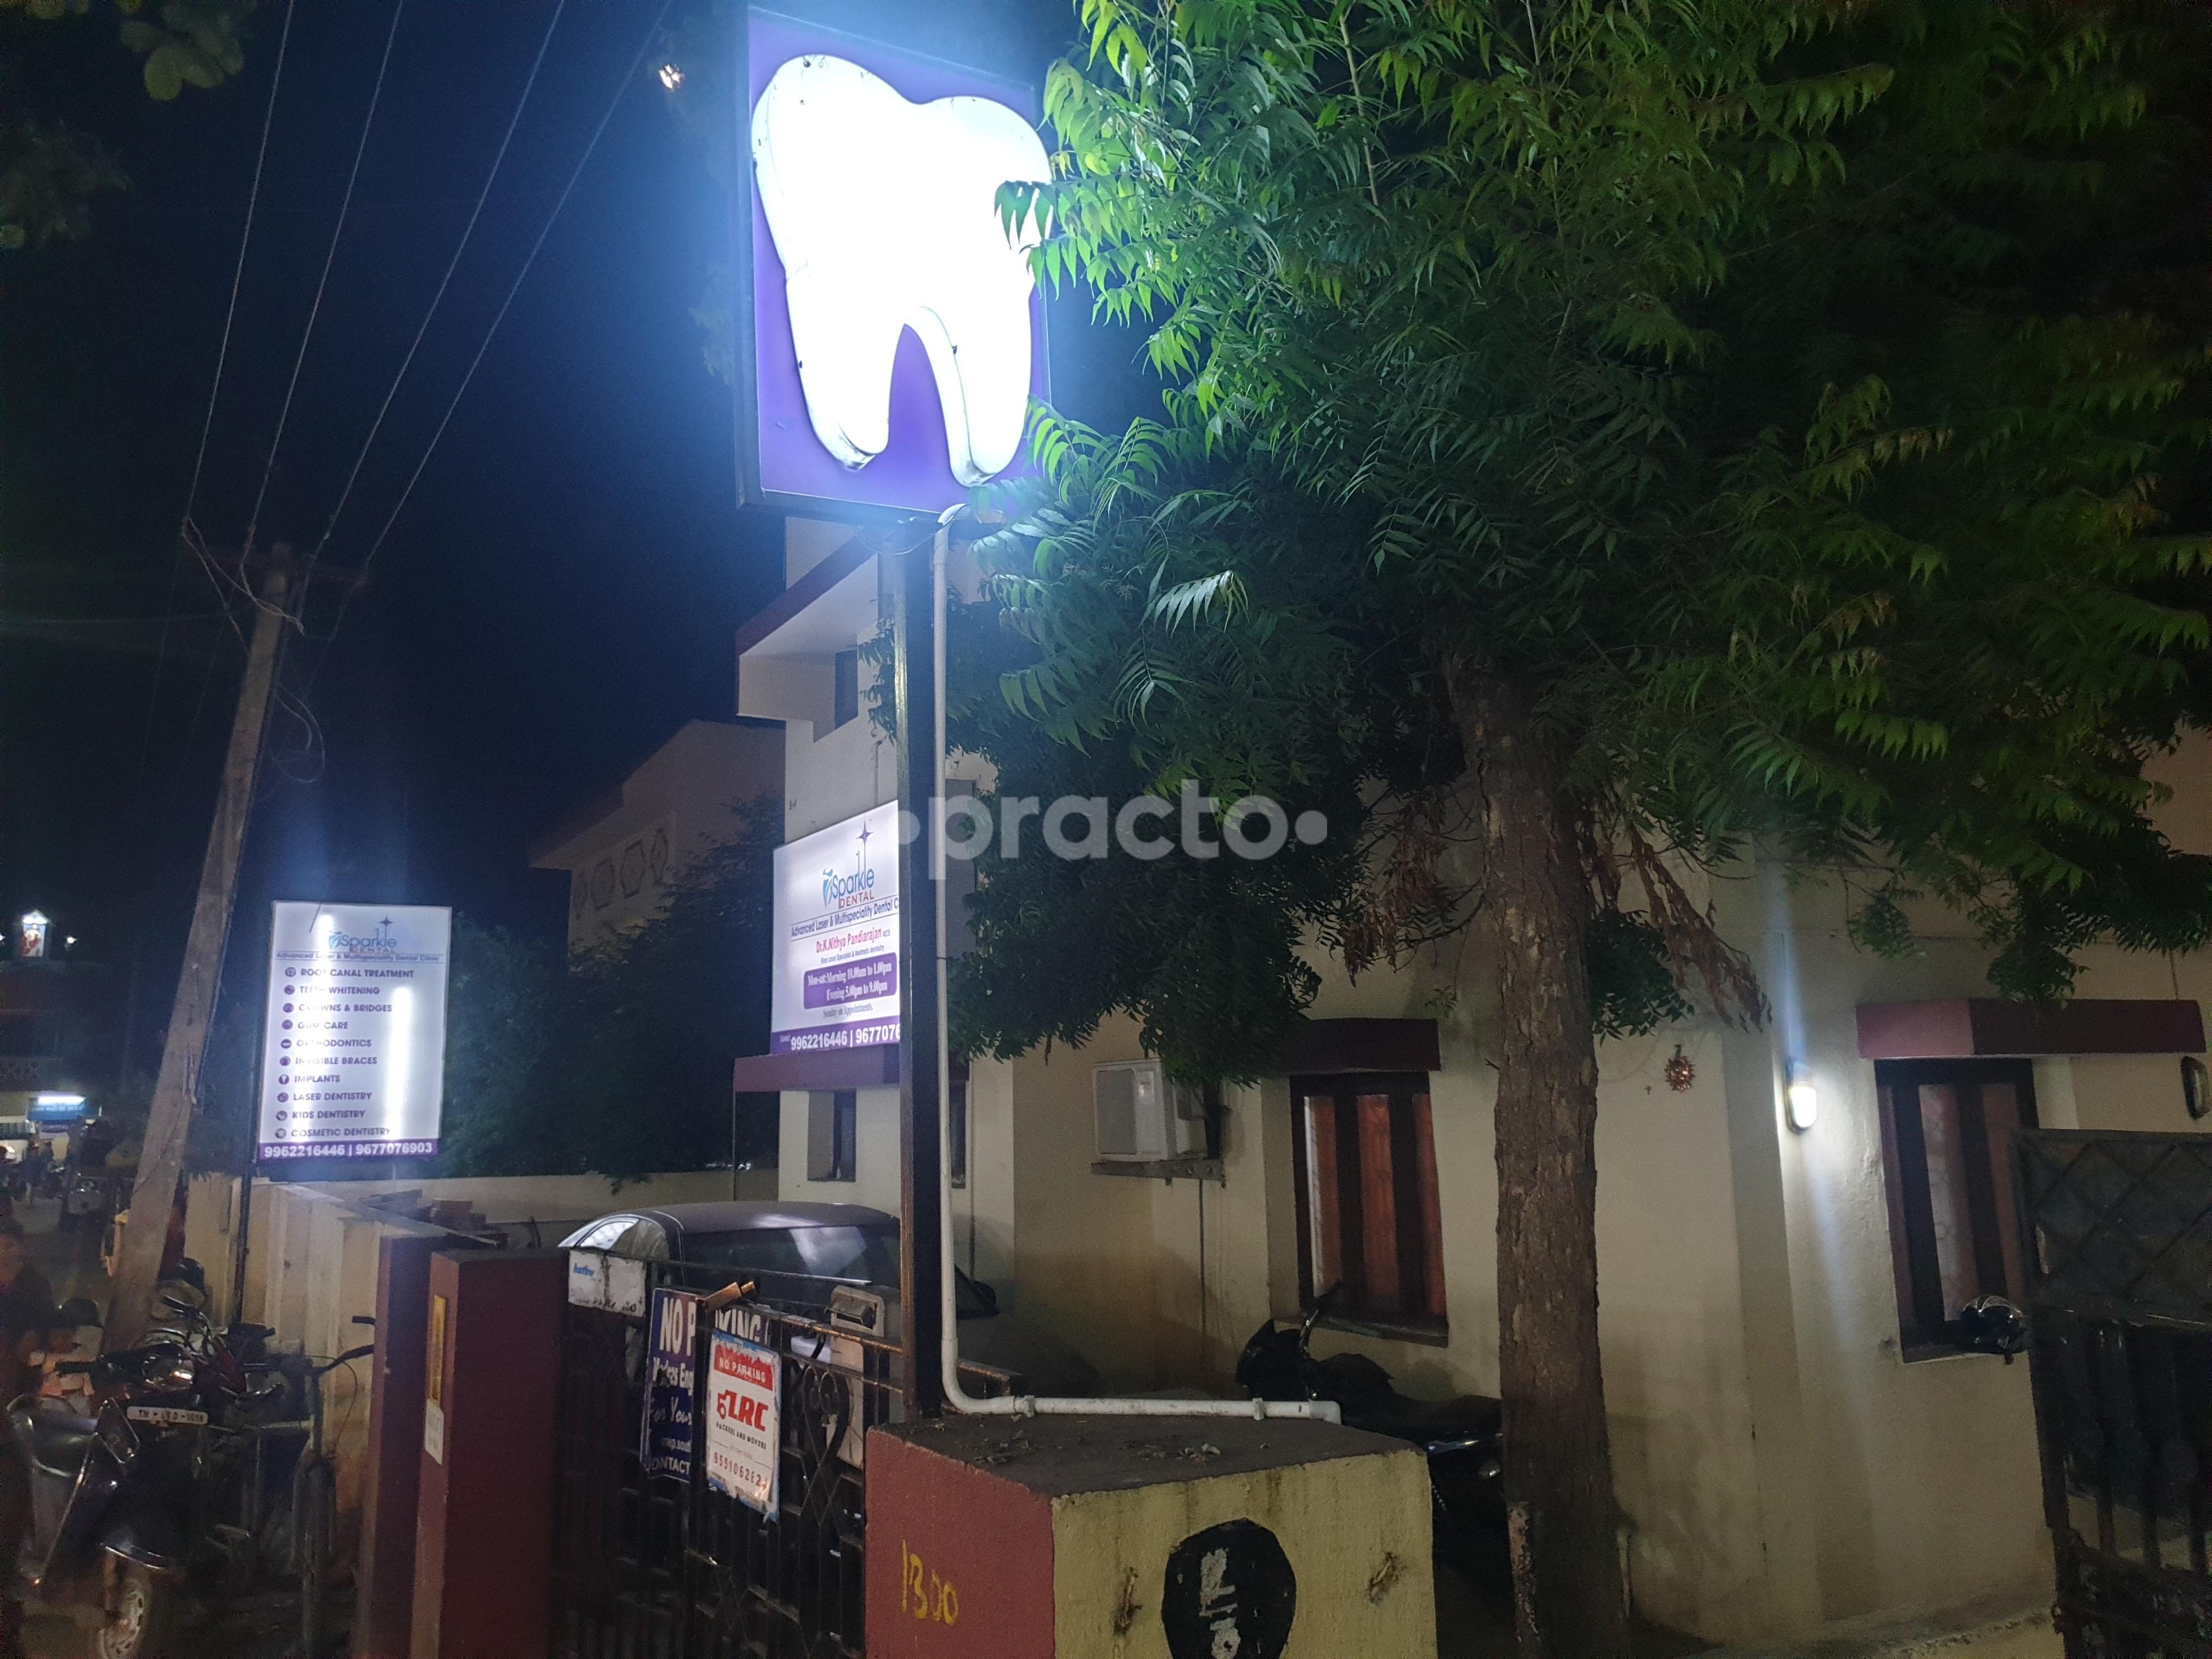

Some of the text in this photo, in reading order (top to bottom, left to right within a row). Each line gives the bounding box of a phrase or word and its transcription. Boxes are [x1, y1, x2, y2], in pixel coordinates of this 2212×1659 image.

[832, 860, 874, 909] Sparkle
[839, 890, 874, 909] DENTAL
[791, 921, 815, 937] Advanced
[816, 919, 829, 931] Laser
[830, 917, 833, 927] &
[834, 905, 873, 926] Multispeciality
[874, 900, 893, 915] Dental
[340, 929, 397, 952] Sparkle
[848, 927, 882, 949] Pandiarajan
[867, 965, 872, 975] to
[329, 986, 380, 995] WHITENING
[827, 987, 845, 1001] Evening
[864, 984, 868, 994] to
[353, 1004, 392, 1012] BRIDGES
[791, 1030, 848, 1051] 9962216446
[294, 1075, 341, 1083] IMPLANTS
[324, 1092, 373, 1101] DENTISTRY
[292, 1110, 366, 1119] KIDS DENTISTRY
[344, 1128, 390, 1136] DENTISTRY
[264, 1145, 345, 1158] 9962216446
[356, 1142, 433, 1155] 9677076903
[660, 1297, 683, 1354] NO
[719, 1357, 766, 1383] NO PARKING
[715, 1421, 767, 1450] PACKERS AND MOVERS
[651, 1455, 691, 1475] ONTACT
